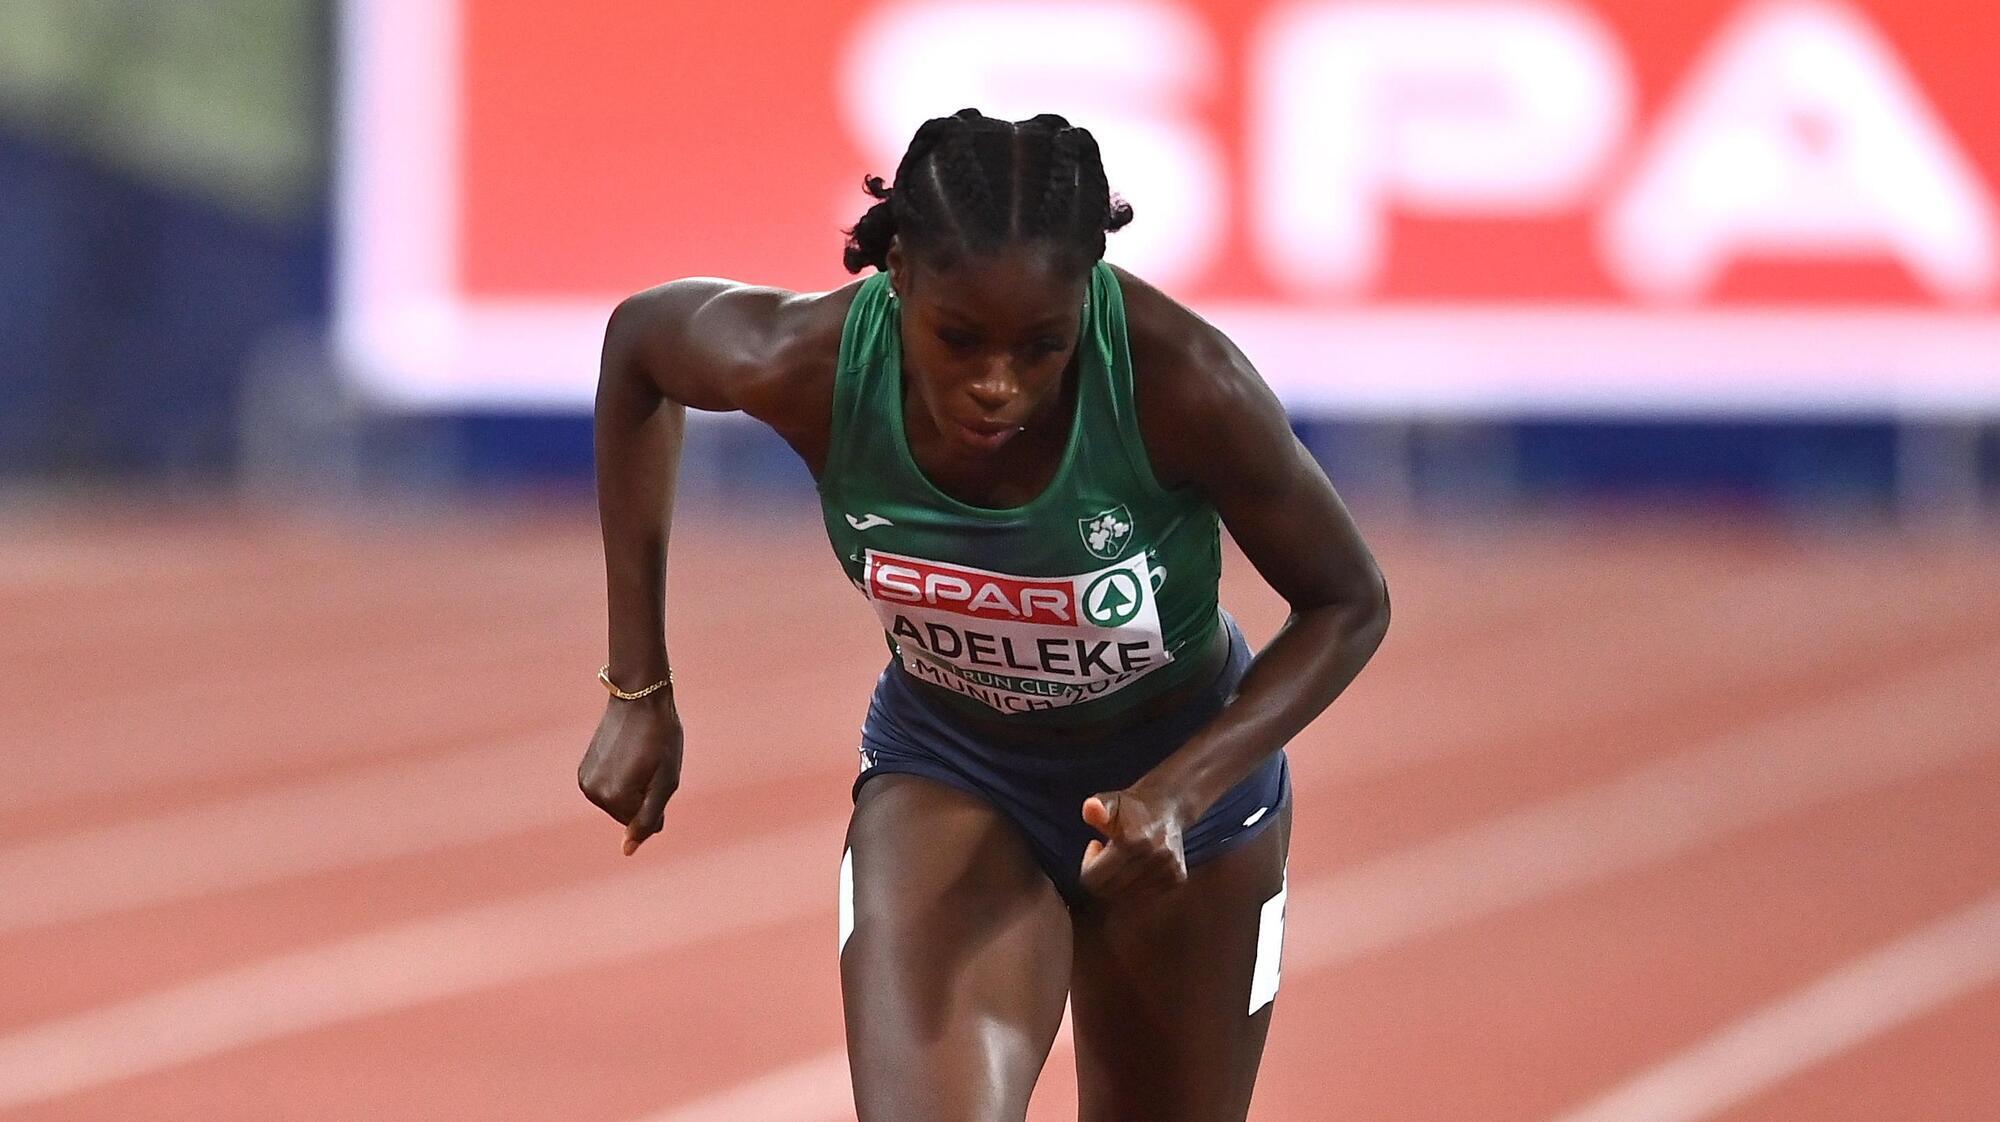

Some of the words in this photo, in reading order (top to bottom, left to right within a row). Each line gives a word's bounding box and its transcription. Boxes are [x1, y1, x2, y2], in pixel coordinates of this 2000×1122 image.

[876, 564, 1070, 621] SPAR
[893, 615, 1152, 677] ADELEKE
[915, 658, 1054, 712] MUNICH
[963, 671, 1012, 690] RUN
[1020, 680, 1082, 698] CLEA
